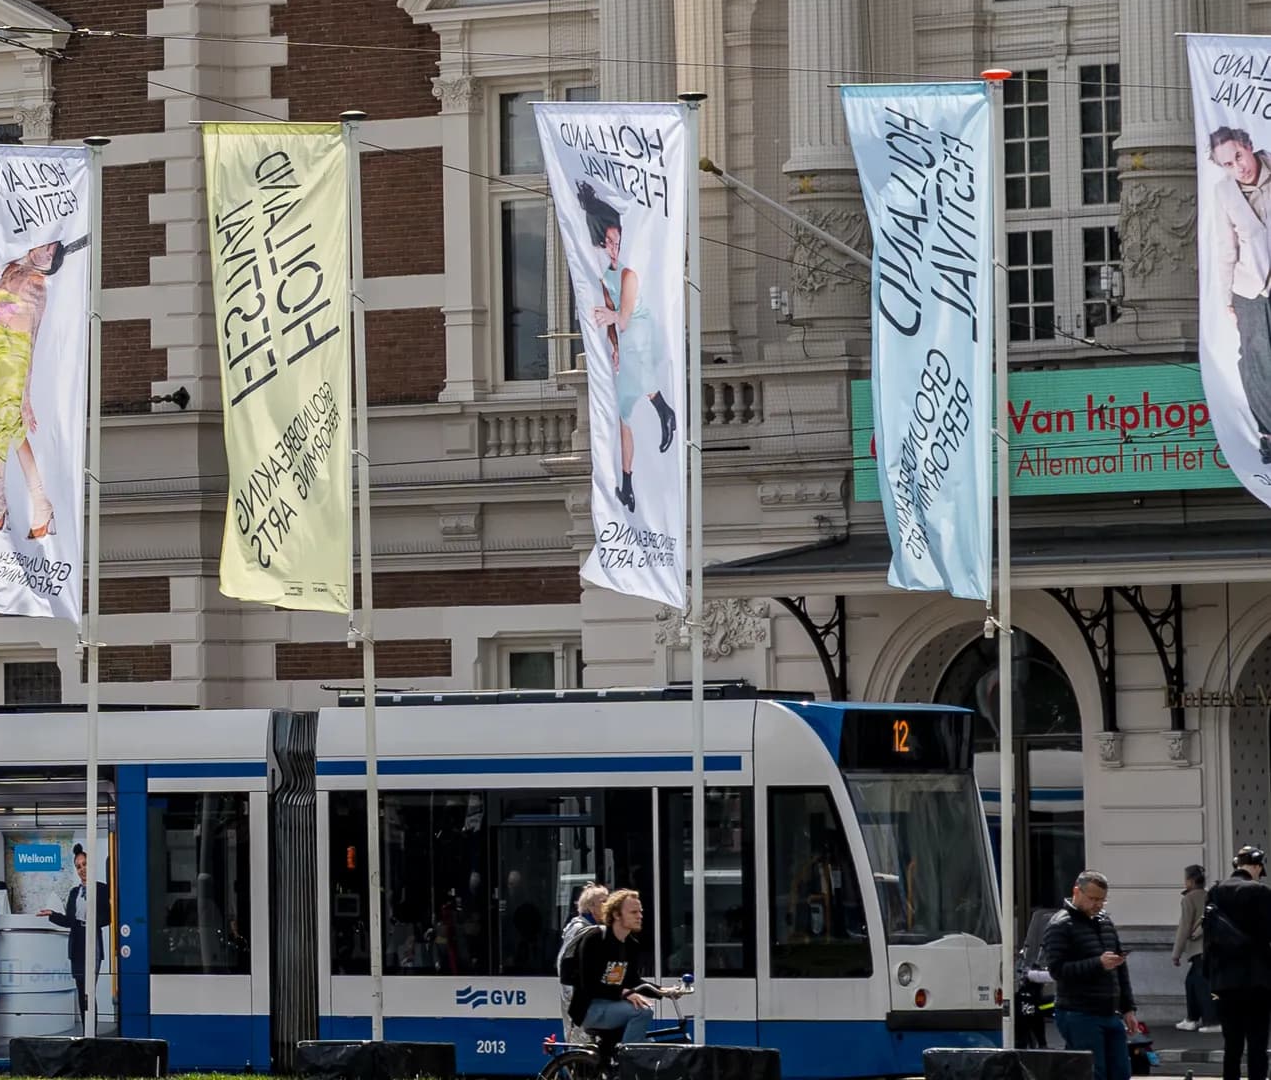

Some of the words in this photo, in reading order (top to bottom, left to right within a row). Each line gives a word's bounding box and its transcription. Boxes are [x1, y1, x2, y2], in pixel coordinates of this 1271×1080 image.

[1009, 400, 1075, 435] Van
[1087, 392, 1210, 438] hiphop
[1016, 445, 1124, 477] Allemaal
[1133, 444, 1153, 472] in
[1162, 444, 1207, 472] Het
[892, 719, 910, 752] 12
[18, 853, 57, 864] Welkom!
[29, 963, 72, 983] Servi
[490, 990, 527, 1005] GVB
[476, 1040, 506, 1053] 2013
